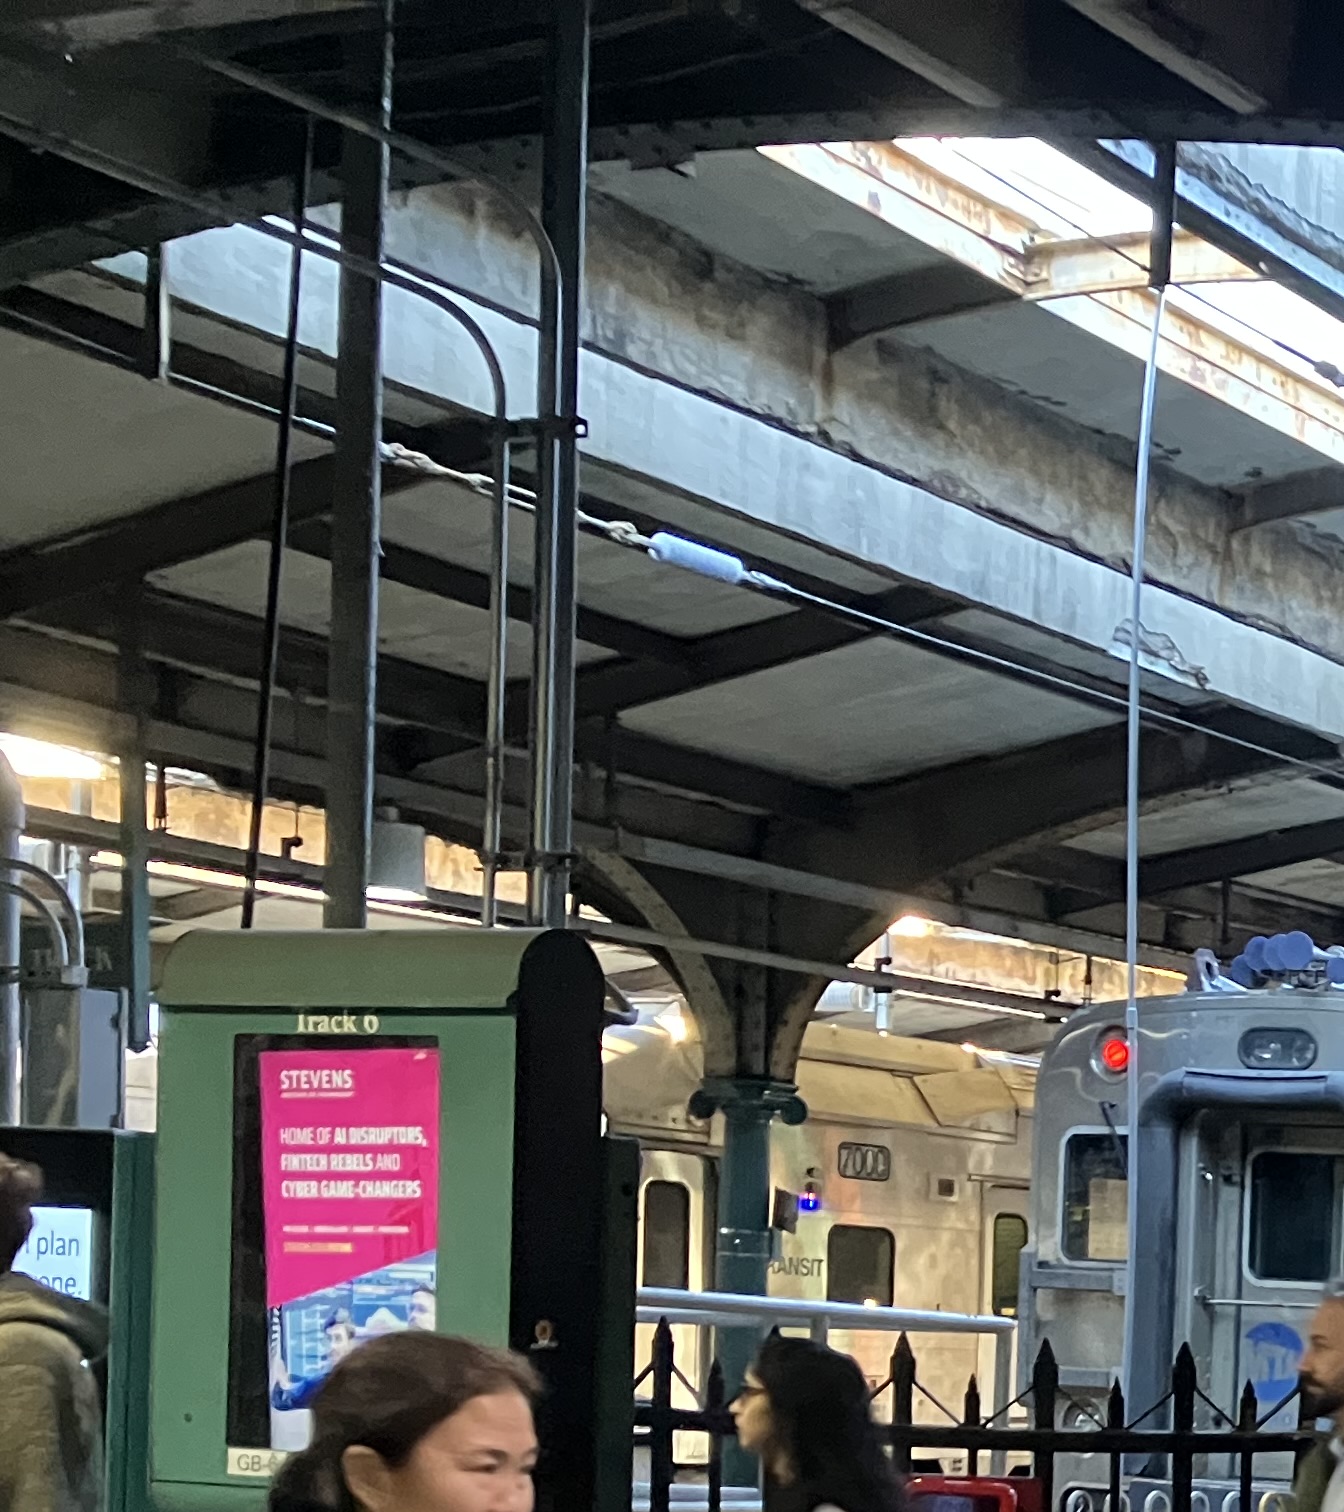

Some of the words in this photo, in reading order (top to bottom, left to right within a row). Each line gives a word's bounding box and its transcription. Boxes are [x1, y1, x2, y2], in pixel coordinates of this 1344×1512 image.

[279, 1069, 353, 1090] STEVENS
[279, 1127, 314, 1145] HOME
[316, 1127, 332, 1145] OF
[280, 1154, 328, 1171] FINTECH
[375, 1155, 401, 1171] AND
[281, 1180, 318, 1198] CYBER
[320, 1180, 421, 1198] GAME-CHANGERS
[37, 1230, 80, 1261] plan
